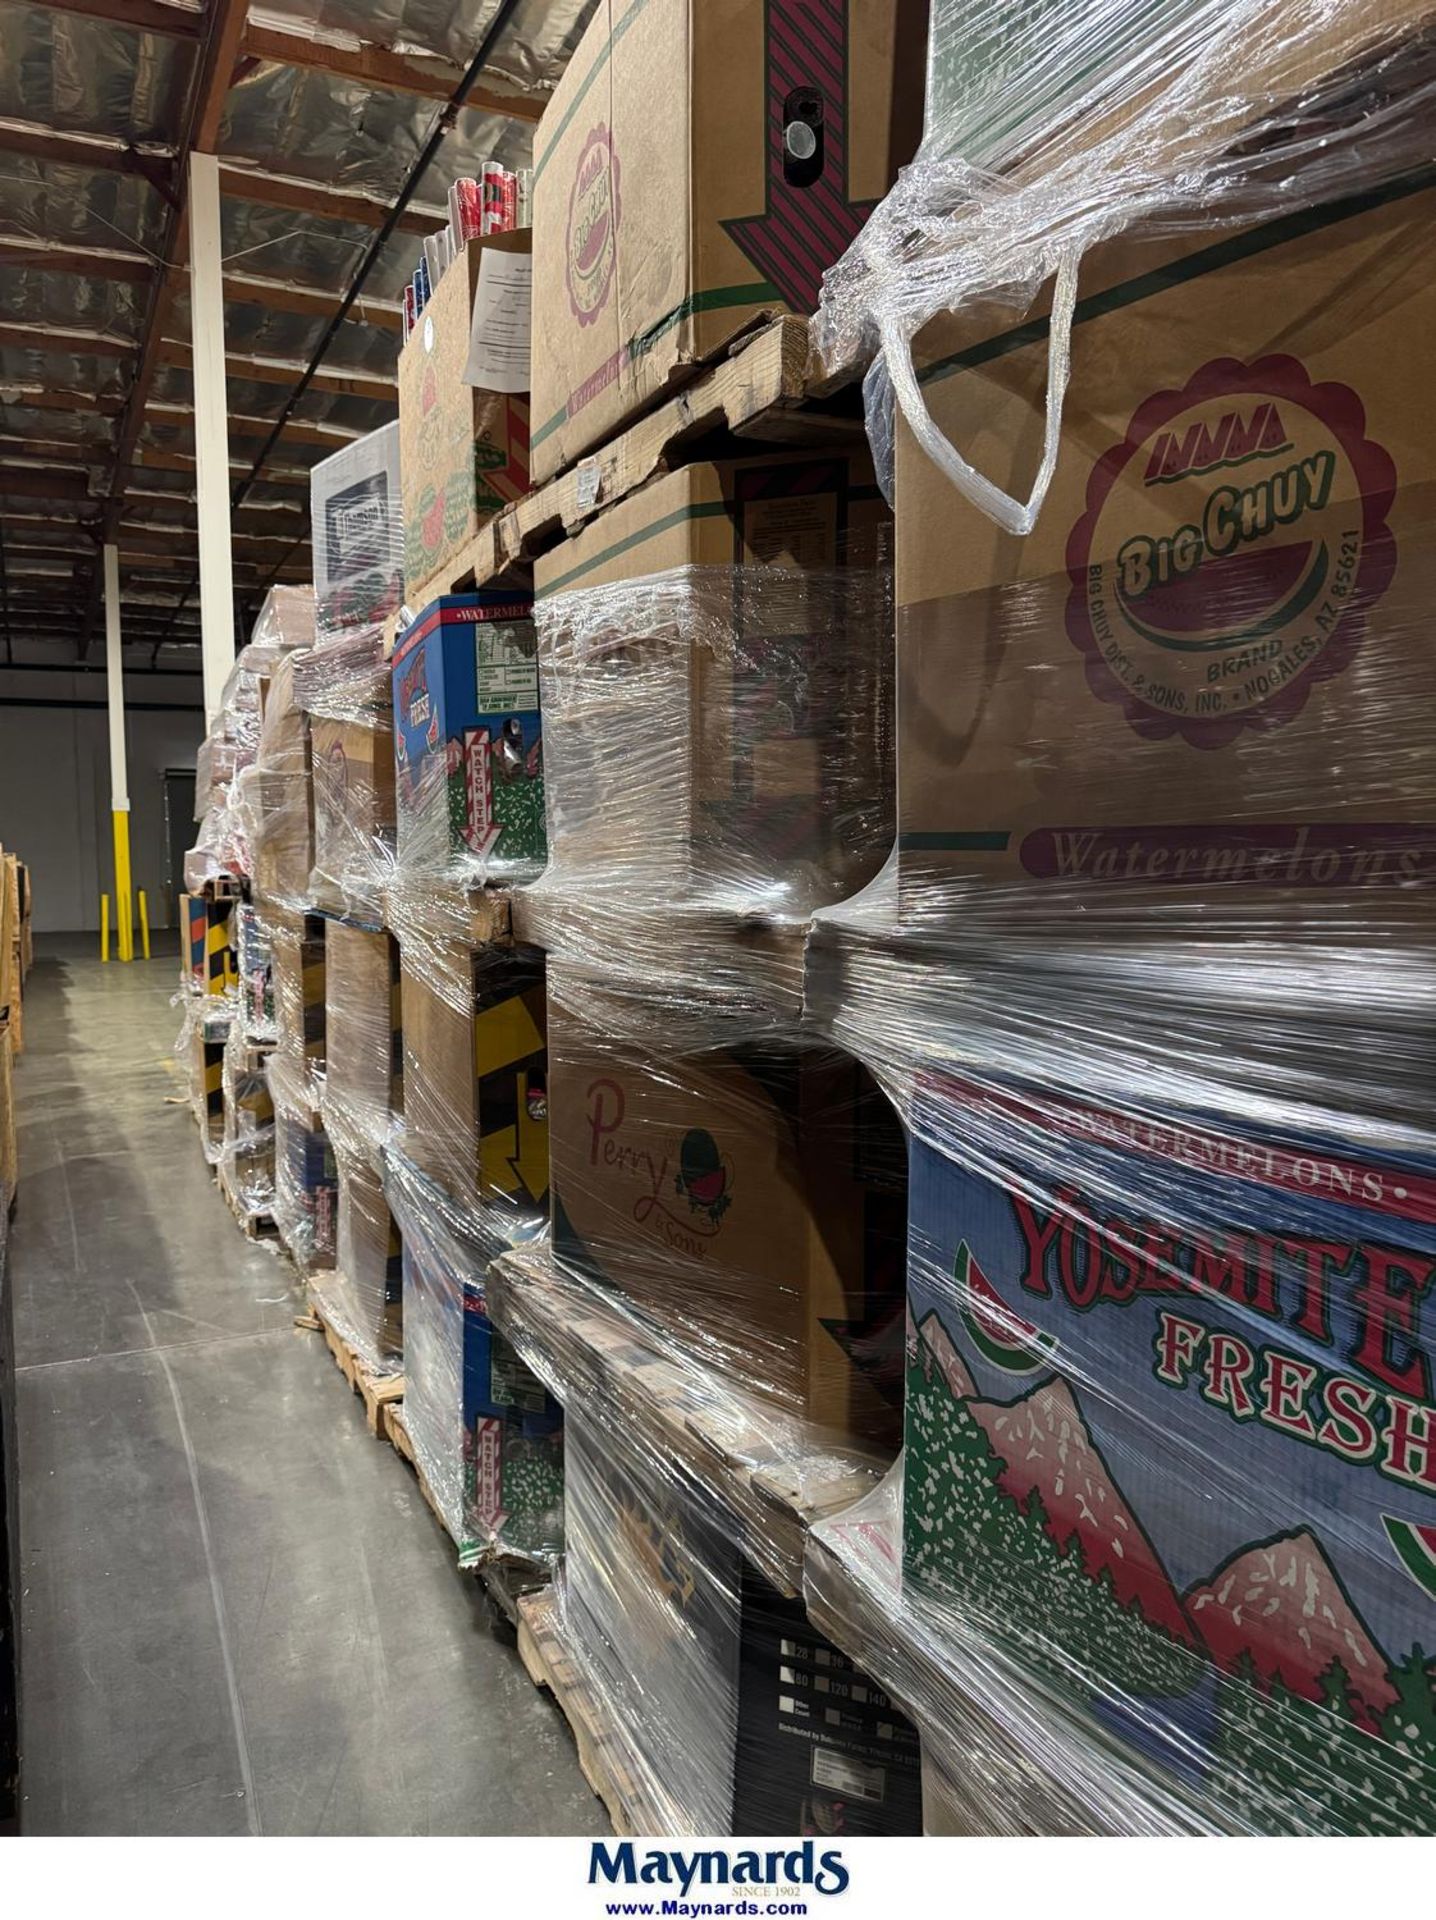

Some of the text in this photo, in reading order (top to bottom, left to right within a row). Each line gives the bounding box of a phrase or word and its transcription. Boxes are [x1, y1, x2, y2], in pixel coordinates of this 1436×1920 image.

[1088, 564, 1103, 596] BIG
[1332, 528, 1360, 598] 85621
[1090, 600, 1113, 643] CHUY
[1315, 602, 1339, 633] AZ
[1206, 639, 1284, 683] BRAND
[1243, 634, 1323, 701] NOGALES,
[1195, 693, 1228, 713] INC.
[472, 748, 485, 832] WATCH STEP
[1049, 828, 1425, 886] Watermelons
[584, 1077, 690, 1227] Perry
[1073, 1110, 1384, 1202] WATERMELONS
[665, 1221, 708, 1259] Sons
[1009, 1184, 1436, 1397] YOSEMITE
[1157, 1311, 1436, 1492] FRESH
[483, 1435, 493, 1515] WATCH STEP
